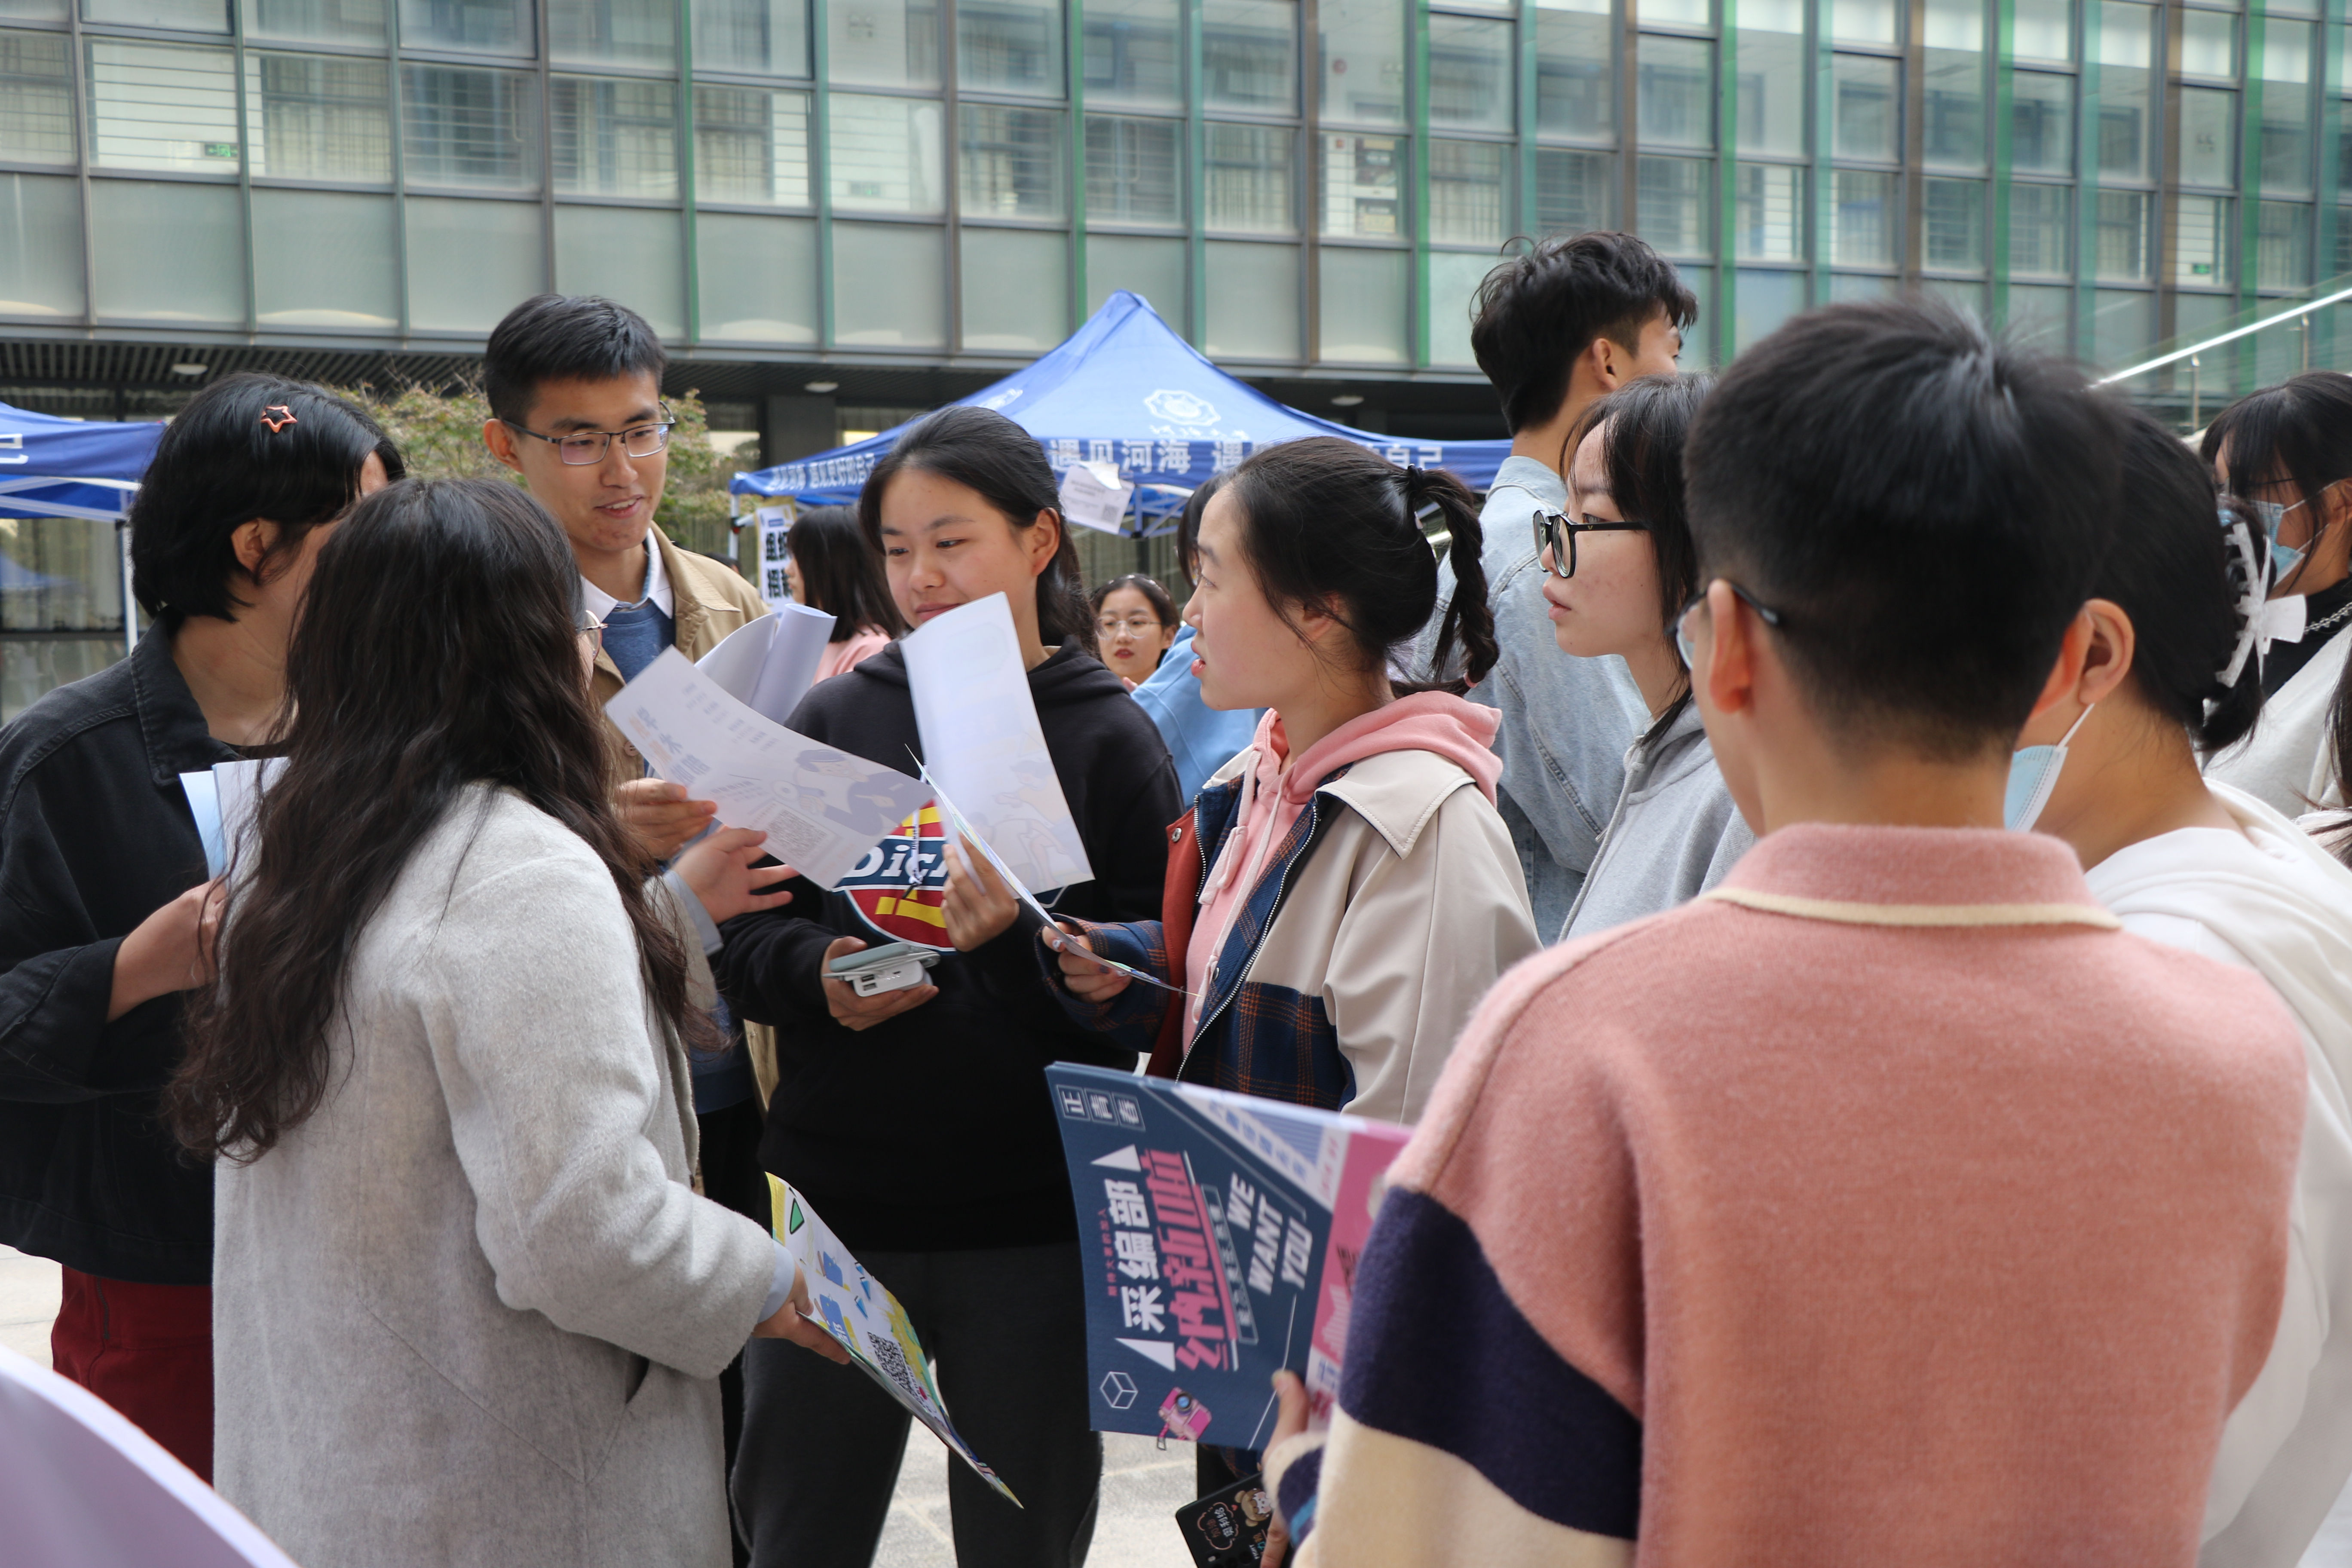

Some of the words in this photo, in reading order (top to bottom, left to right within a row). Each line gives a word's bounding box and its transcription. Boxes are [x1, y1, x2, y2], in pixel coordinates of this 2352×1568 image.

[1048, 439, 1192, 475] 遇见河海
[843, 843, 948, 879] Dic
[1061, 1090, 1140, 1125] 正青春
[1227, 1173, 1255, 1231] WE
[1105, 1178, 1167, 1333] 采编部
[1140, 1148, 1228, 1371] 纳新啦
[1248, 1194, 1283, 1295] WANT
[1281, 1220, 1313, 1290] YOU
[1213, 1507, 1235, 1538] 奥利给
